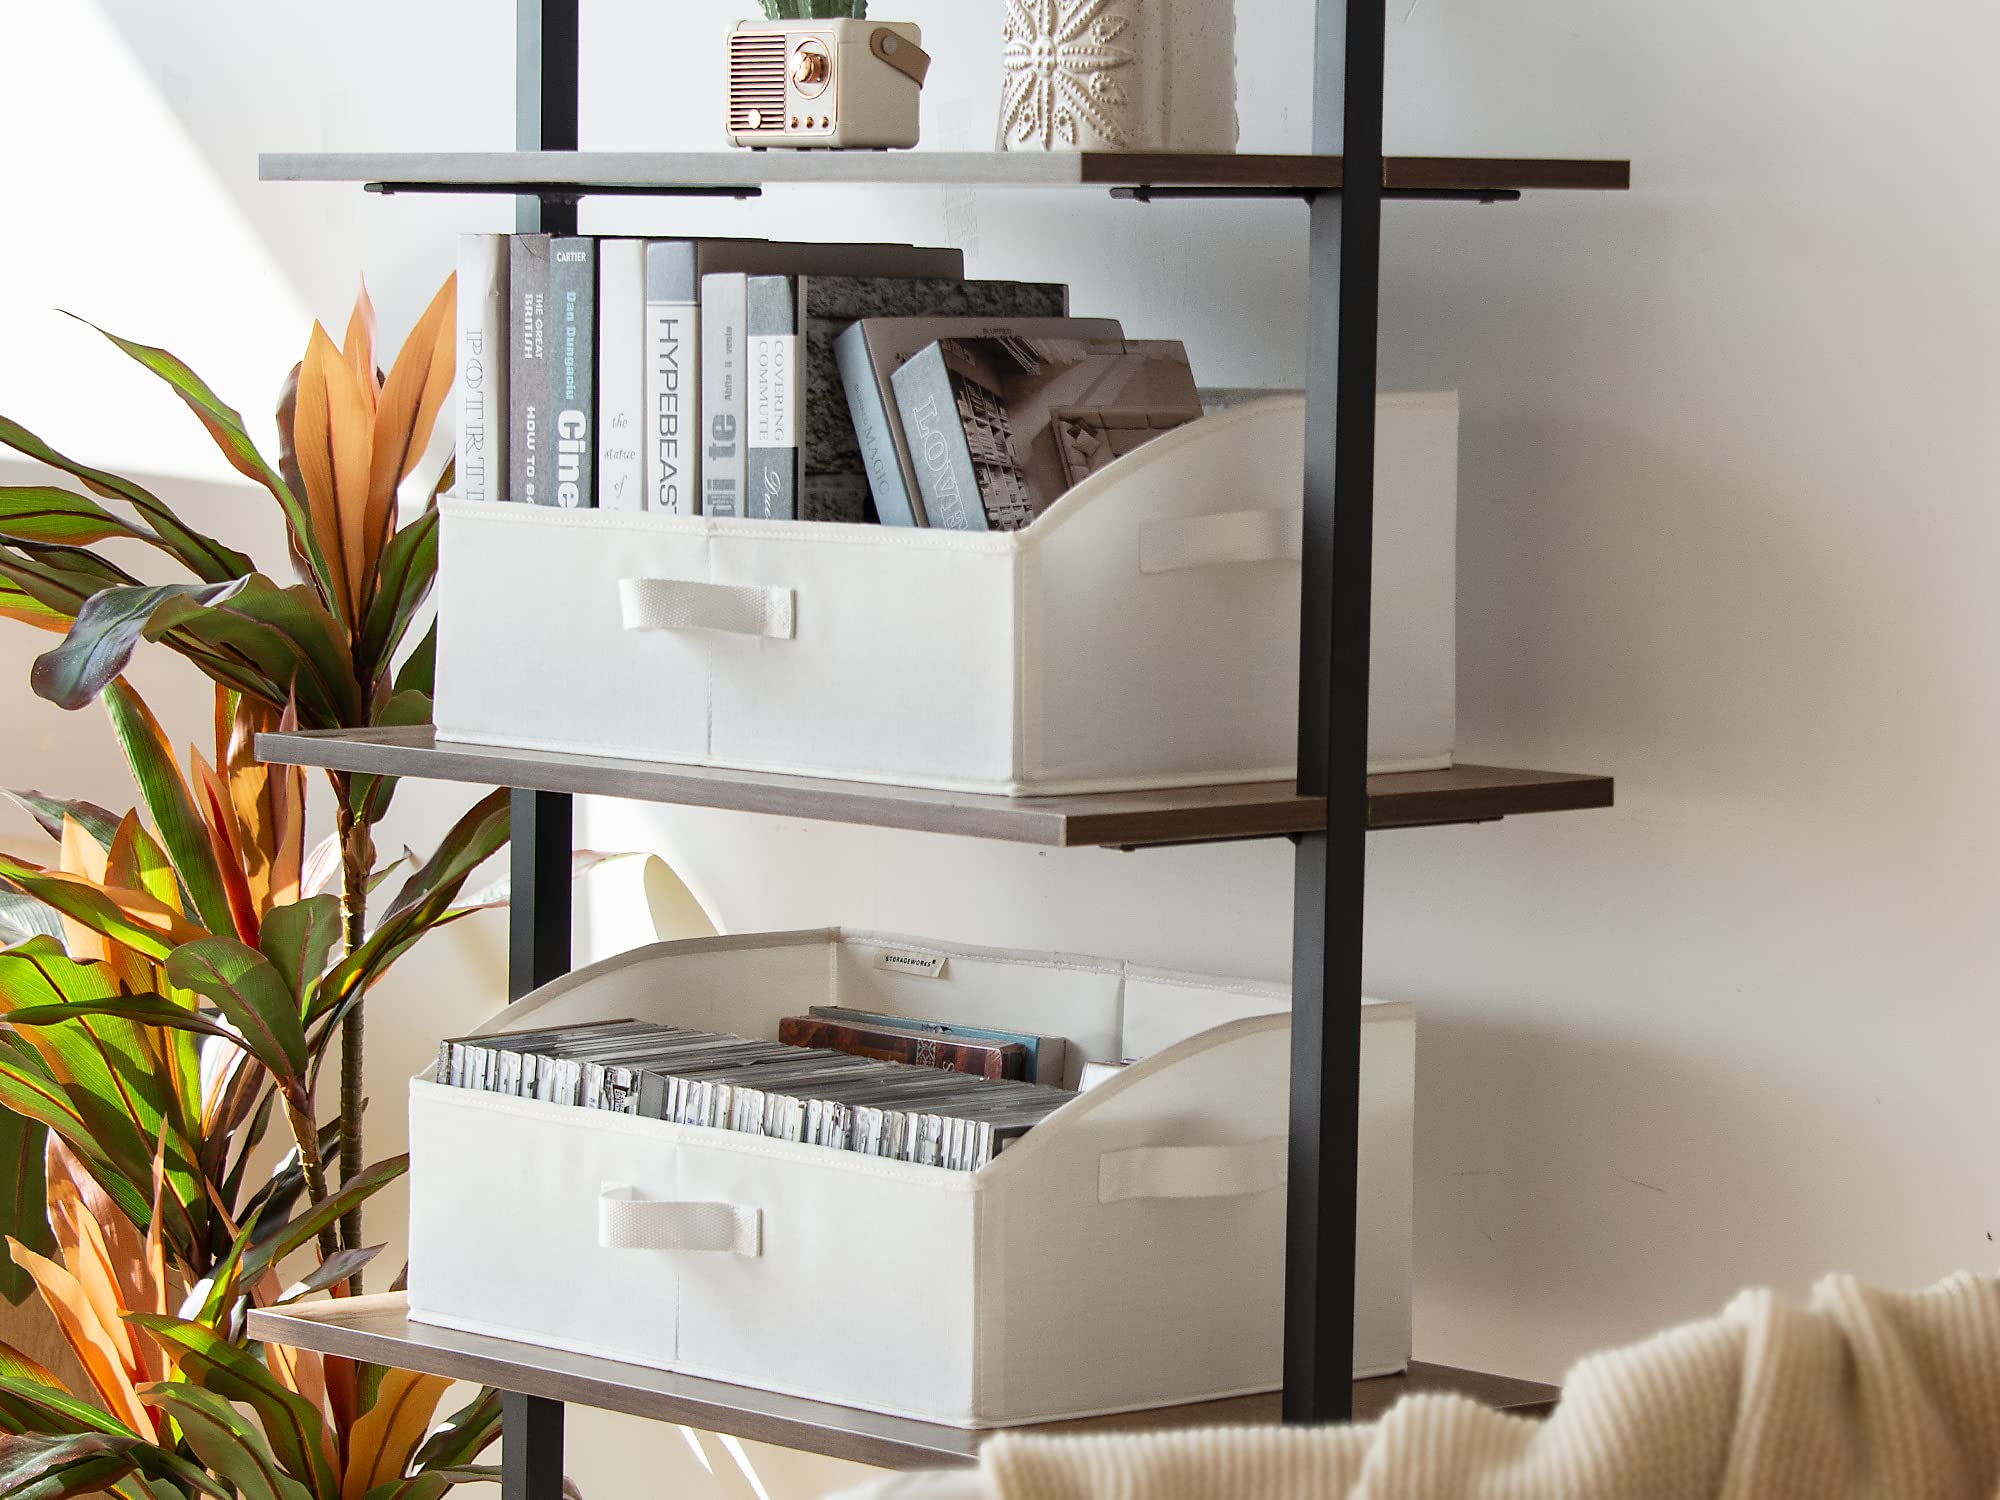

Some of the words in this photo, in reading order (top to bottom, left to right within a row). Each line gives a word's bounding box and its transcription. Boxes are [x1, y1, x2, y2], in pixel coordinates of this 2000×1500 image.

[556, 251, 587, 263] CARTIER
[535, 293, 544, 314] THE
[565, 291, 577, 322] Dan
[524, 293, 534, 359] BRITISH
[534, 317, 544, 359] GREAT
[564, 326, 577, 400] Dungaciu
[759, 340, 769, 442] COMMUTE
[774, 340, 785, 442] COVERING
[526, 405, 536, 451] HOW
[612, 412, 628, 429] the
[659, 319, 679, 515] HYPEBEAS
[708, 414, 737, 461] te
[526, 455, 536, 478] TO
[605, 448, 636, 461] statue
[864, 425, 891, 496] MAGIC
[613, 474, 628, 499] of
[885, 955, 932, 968] STORAGEWORKS
